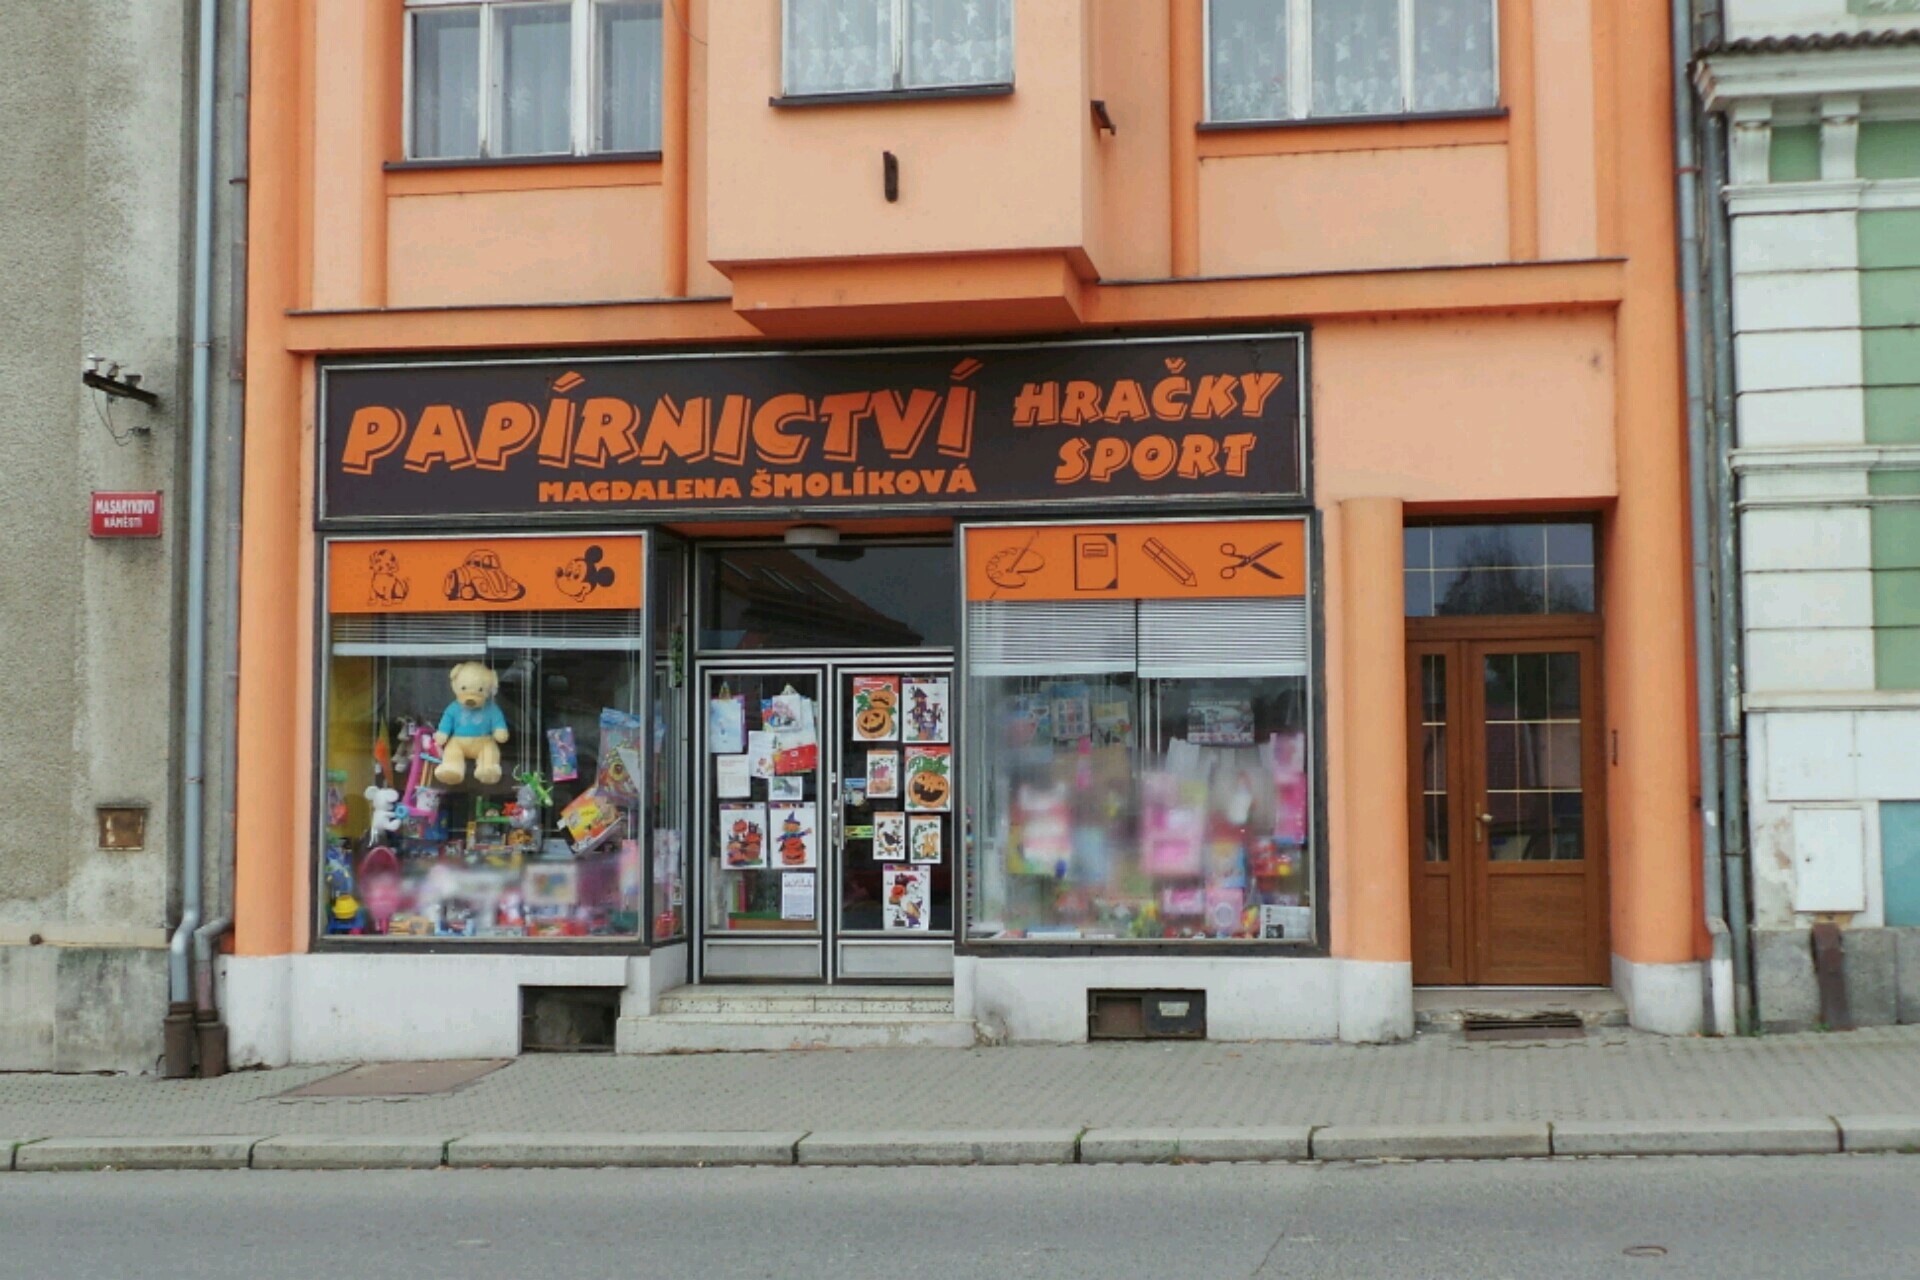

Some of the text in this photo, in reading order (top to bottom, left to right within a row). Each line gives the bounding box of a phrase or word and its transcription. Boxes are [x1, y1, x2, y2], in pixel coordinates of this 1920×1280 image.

[342, 359, 982, 474] PAPÍRNICTVÍ
[1013, 358, 1281, 425] HRAČKY
[538, 465, 977, 502] MAGDALENA ŠMOLÍKOVÁ
[1055, 434, 1256, 485] SPORT
